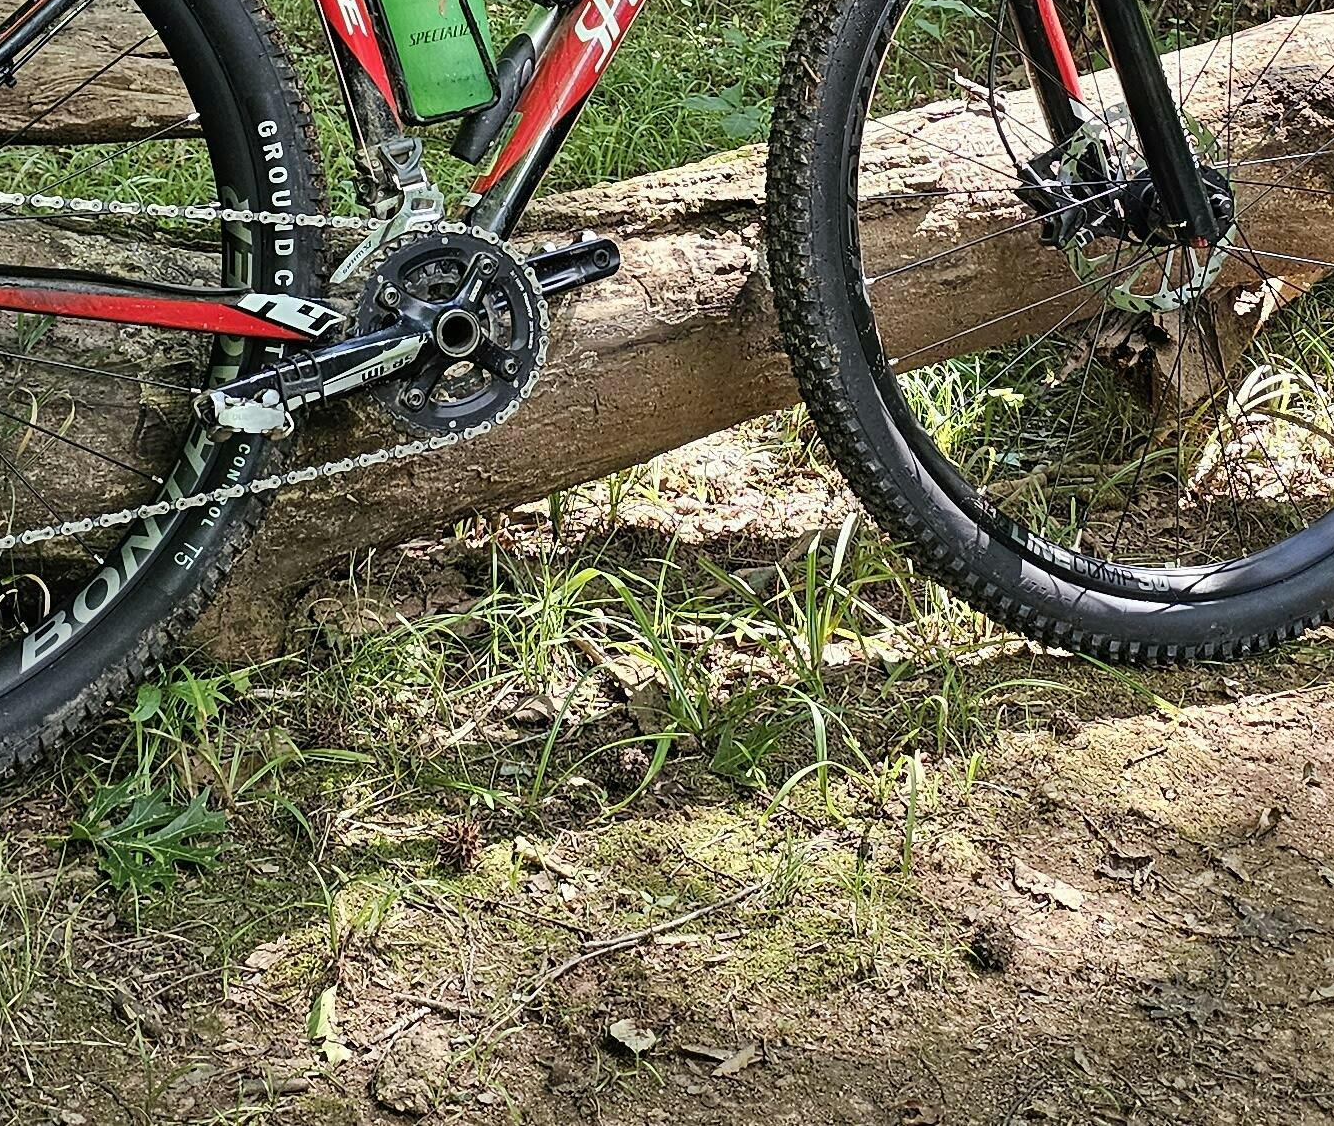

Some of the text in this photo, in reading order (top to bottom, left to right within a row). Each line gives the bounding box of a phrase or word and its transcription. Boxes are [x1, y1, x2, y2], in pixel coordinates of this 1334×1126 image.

[409, 24, 471, 47] SPECIALIZ
[1011, 527, 1072, 570] LINE
[1073, 555, 1134, 586] COMP
